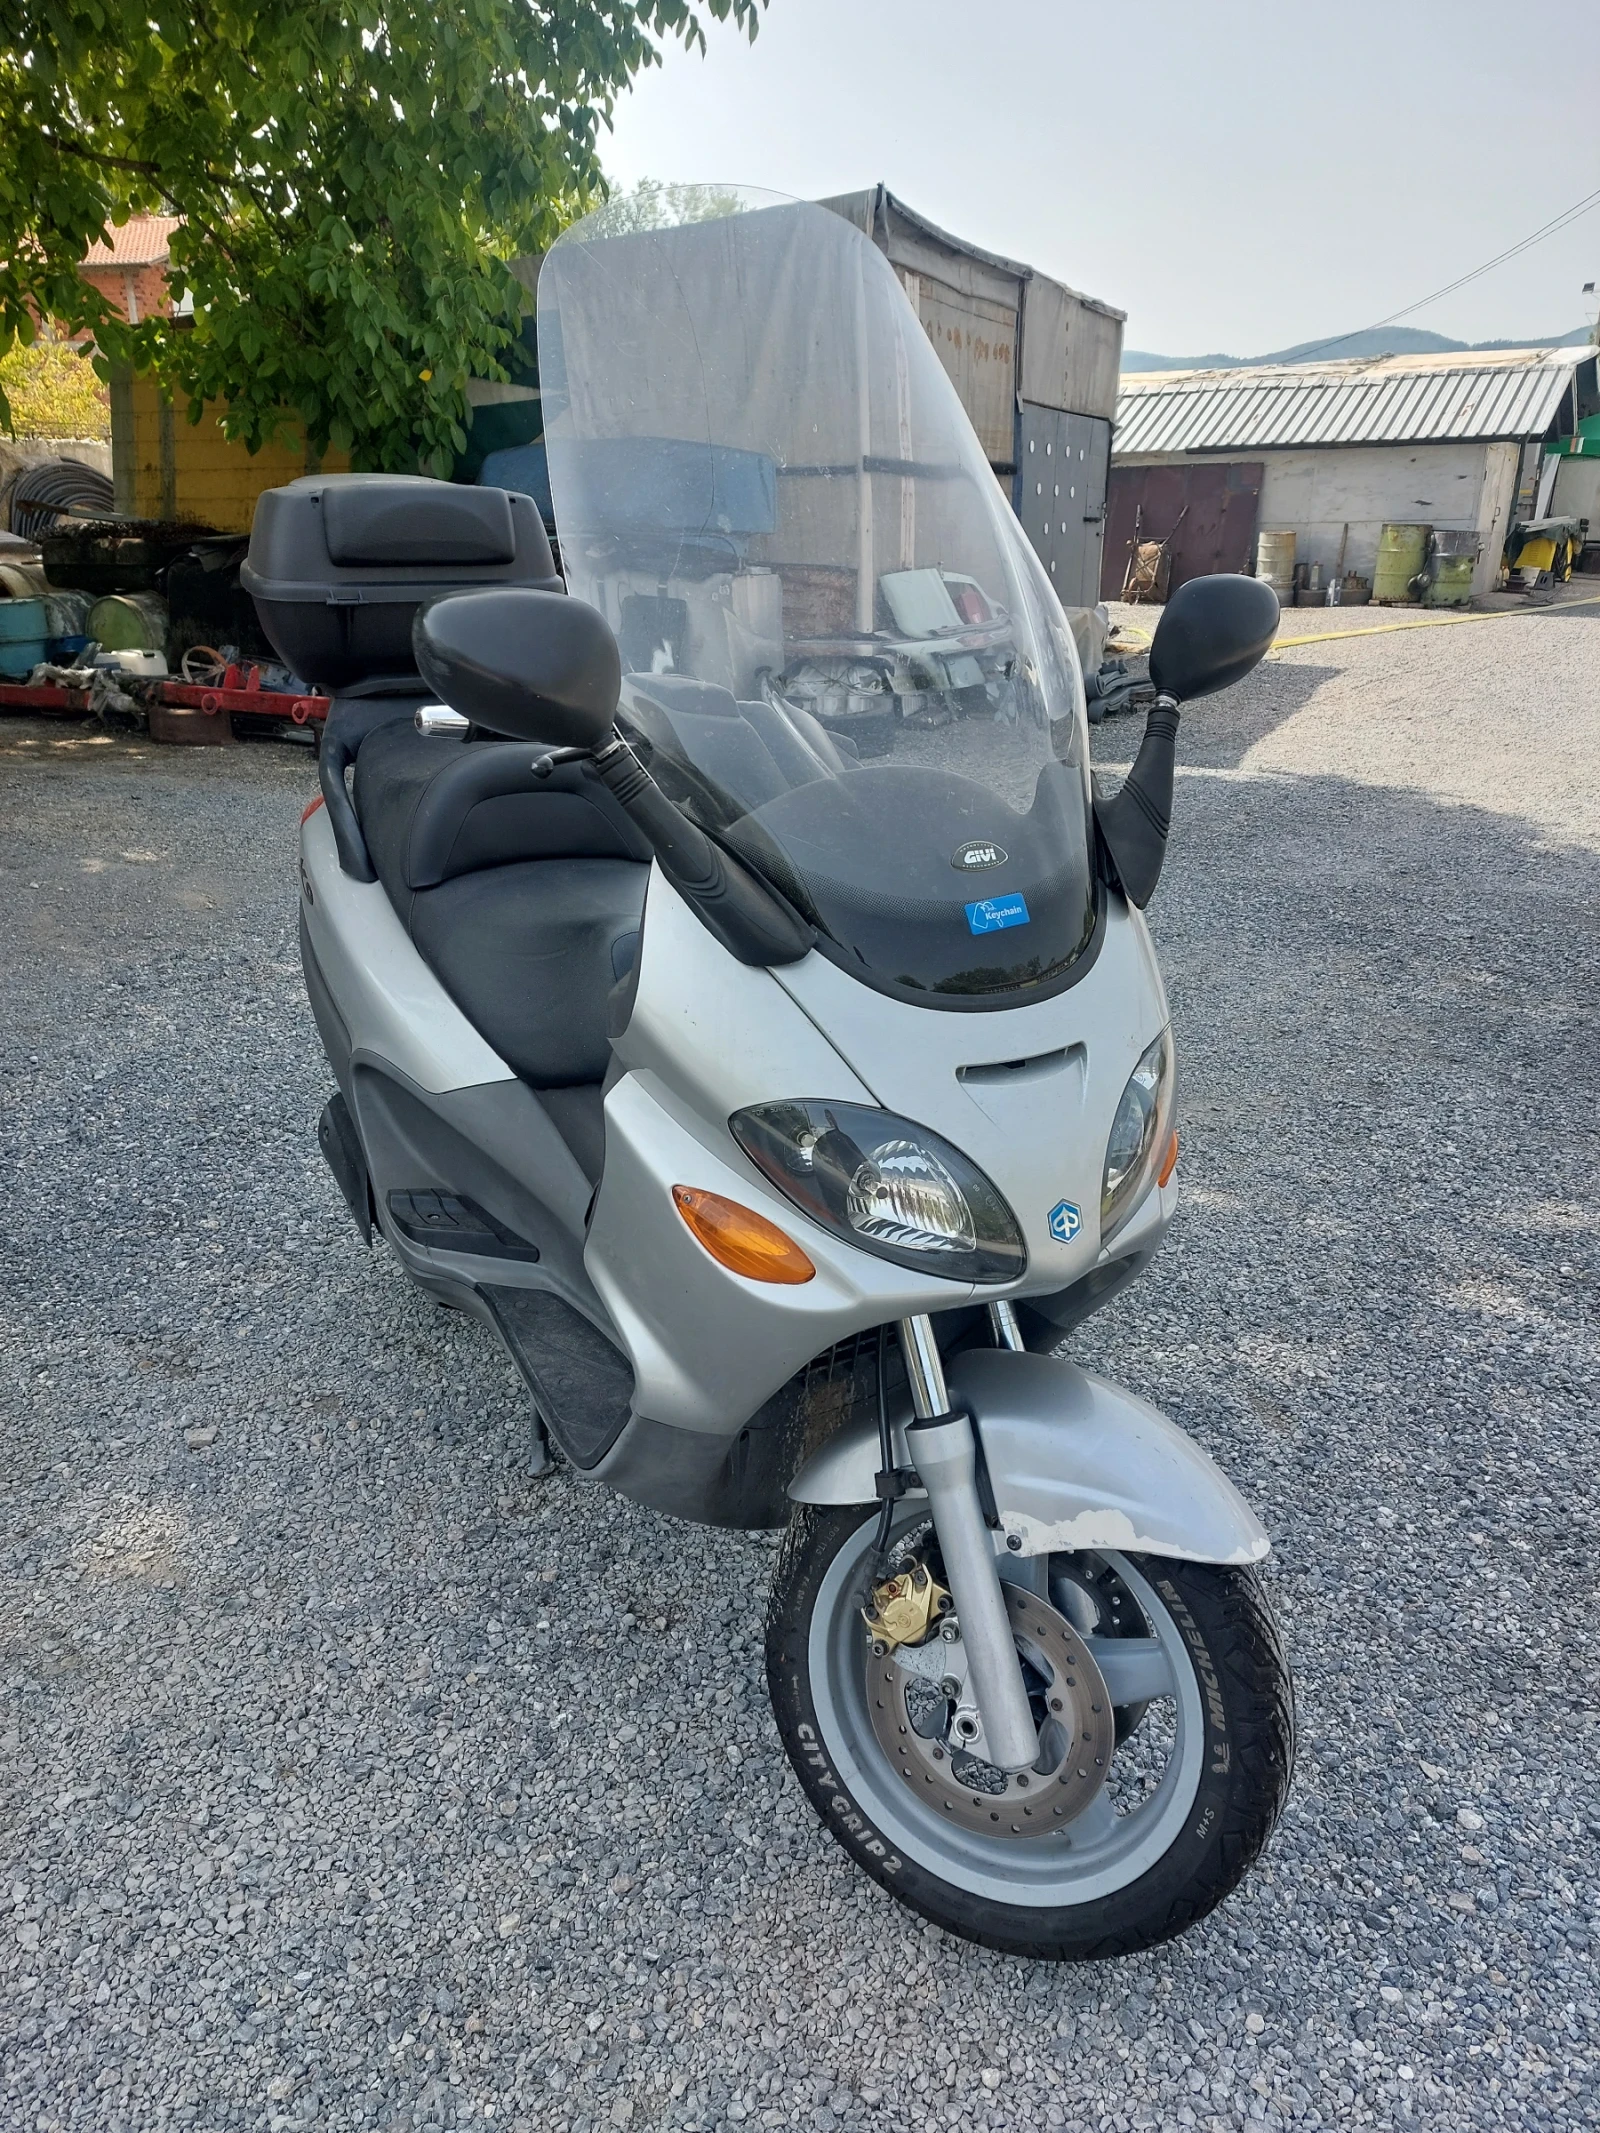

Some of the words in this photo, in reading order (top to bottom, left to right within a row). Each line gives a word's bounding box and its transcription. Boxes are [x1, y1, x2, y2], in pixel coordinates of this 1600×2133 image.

[963, 847, 997, 864] GIVI
[984, 905, 1023, 921] Keychain
[1156, 1580, 1226, 1731] MICHELIN
[797, 1723, 838, 1790] CITY
[831, 1794, 886, 1857] GRIP
[882, 1855, 903, 1875] 2
[1195, 1807, 1215, 1840] M+S
